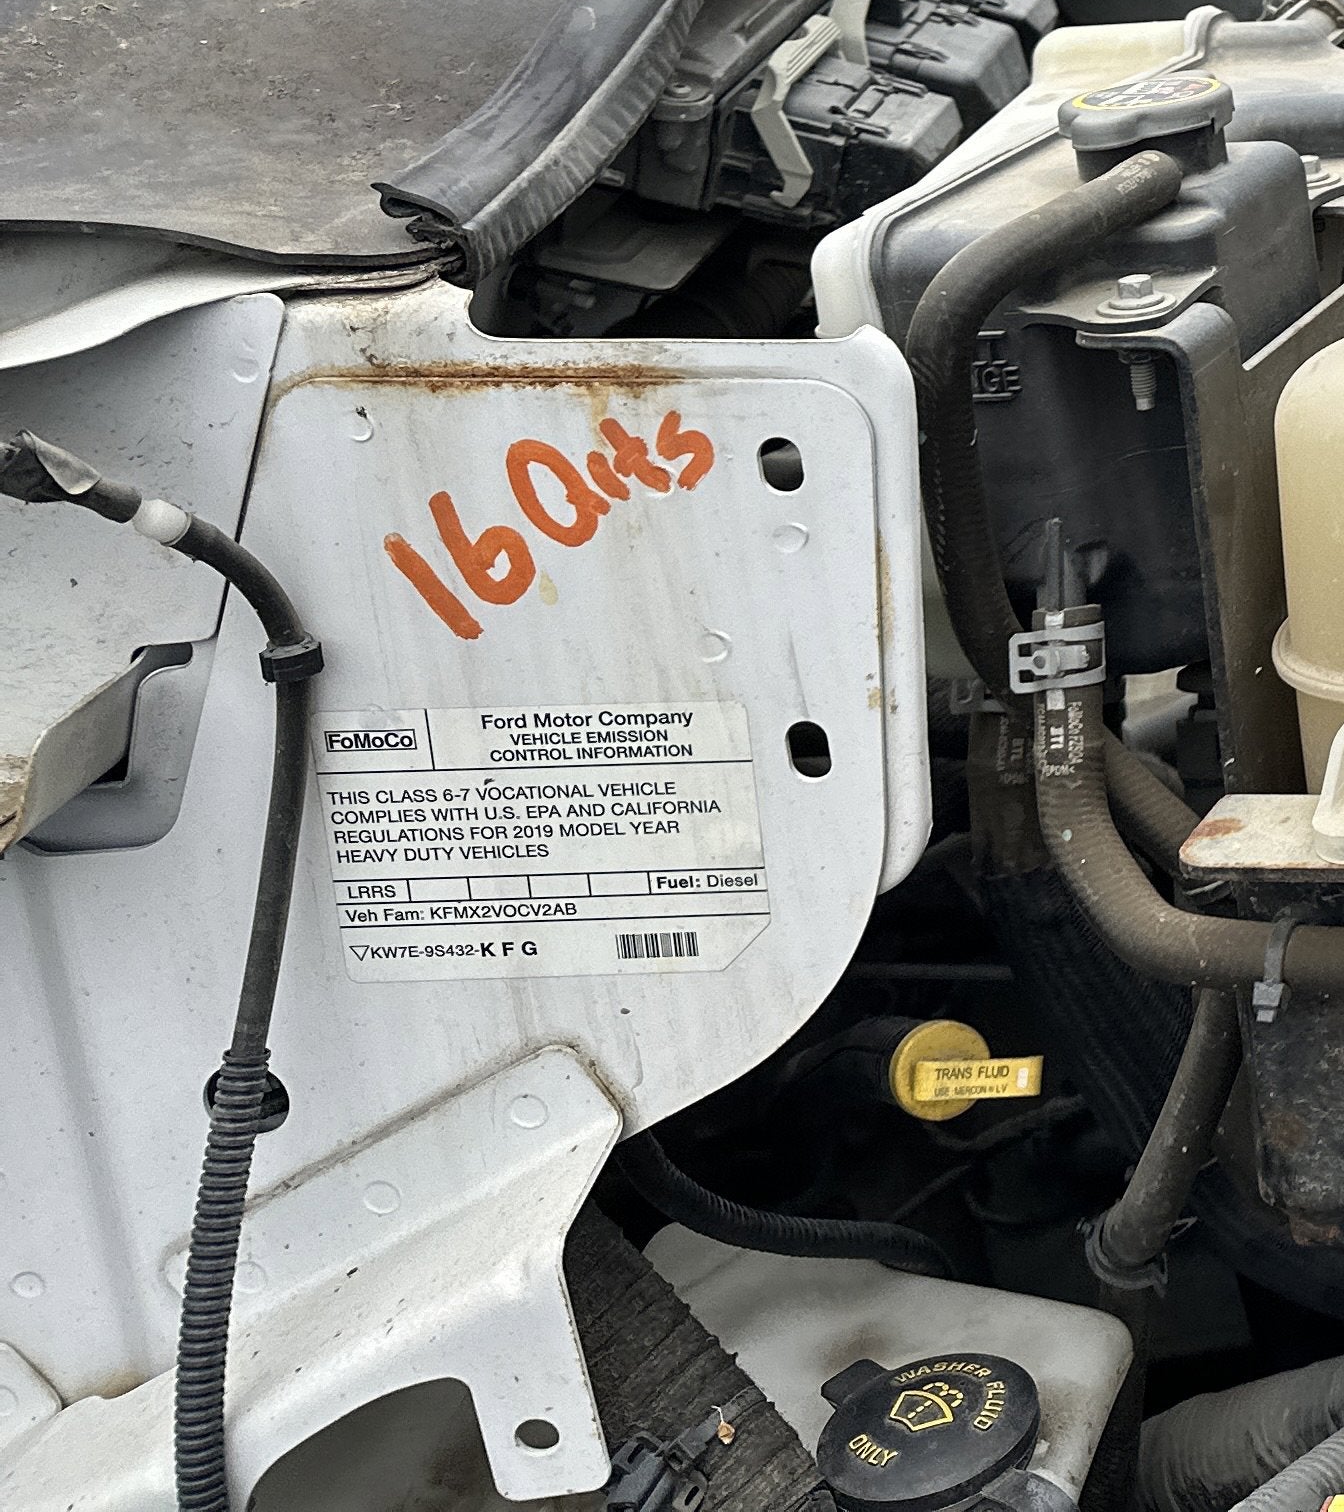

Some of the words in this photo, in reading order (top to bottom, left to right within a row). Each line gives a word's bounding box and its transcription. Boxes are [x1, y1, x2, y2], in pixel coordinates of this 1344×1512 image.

[384, 491, 536, 640] 16
[481, 713, 527, 730] Ford
[534, 712, 593, 729] Motor
[598, 710, 693, 728] Company
[327, 732, 414, 750] FoMoCo
[510, 732, 581, 746] VEHICLE
[586, 729, 669, 744] EMISSION
[490, 747, 573, 762] CONTROL
[577, 744, 693, 759] INFORMATION
[326, 791, 370, 805] THIS
[376, 789, 438, 804] CLASS
[443, 788, 470, 802] 6-7
[476, 784, 594, 801] VOCATIONAL
[598, 781, 677, 797] VEHICLE
[331, 808, 426, 824] COMPLIES
[431, 807, 478, 822] WITH
[484, 806, 521, 821] U.S.
[526, 804, 561, 819] EPA
[566, 803, 606, 818] AND
[611, 799, 722, 816] CALIFORNIA
[334, 826, 465, 844] REGULATIONS
[470, 825, 508, 840] FOR
[513, 824, 554, 839] 2019
[559, 822, 626, 837] MODEL
[629, 820, 680, 835] YEAR
[337, 848, 398, 863] HEAVY
[404, 846, 454, 861] DUTY
[459, 843, 549, 860] VEHICLES
[347, 884, 396, 900] LRRS
[656, 873, 702, 890] Fuel:
[706, 871, 759, 888] Diesel
[345, 908, 378, 923] Veh
[383, 906, 424, 922] Fam:
[429, 902, 577, 920] KFMX2VOCV2AB
[502, 941, 514, 957] F
[521, 940, 538, 956] G
[935, 1067, 972, 1081] TRANS
[978, 1065, 1009, 1079] FLUID
[894, 1361, 993, 1384] WASHER
[973, 1380, 1006, 1431] FLUID
[848, 1433, 899, 1468] ONLY
